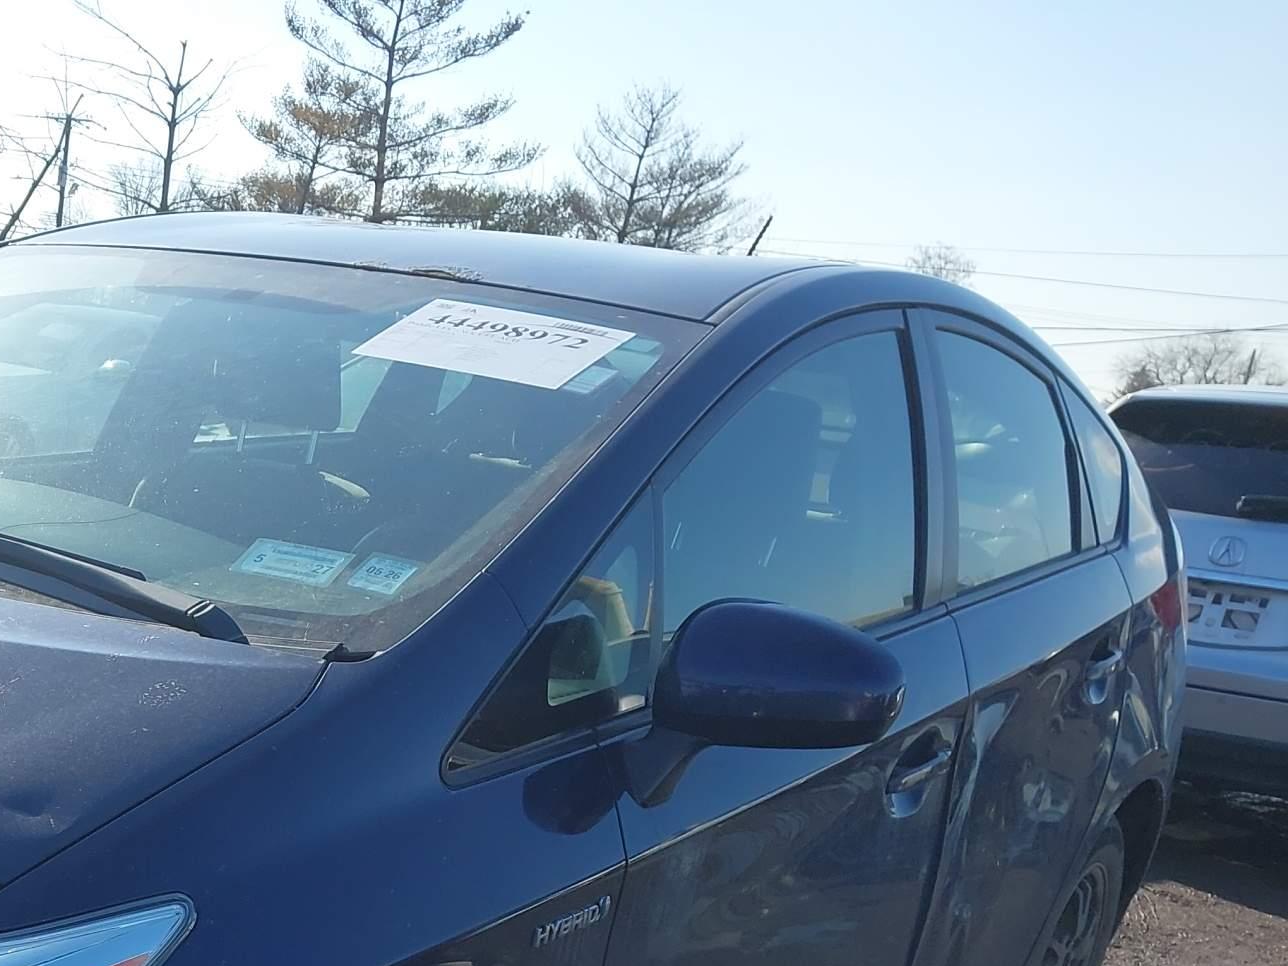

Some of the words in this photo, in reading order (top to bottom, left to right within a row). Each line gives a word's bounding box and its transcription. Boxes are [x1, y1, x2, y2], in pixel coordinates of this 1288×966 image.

[428, 314, 589, 350] 44498972
[253, 553, 267, 563] 5
[312, 564, 335, 575] 27
[534, 904, 601, 948] HYBRID
